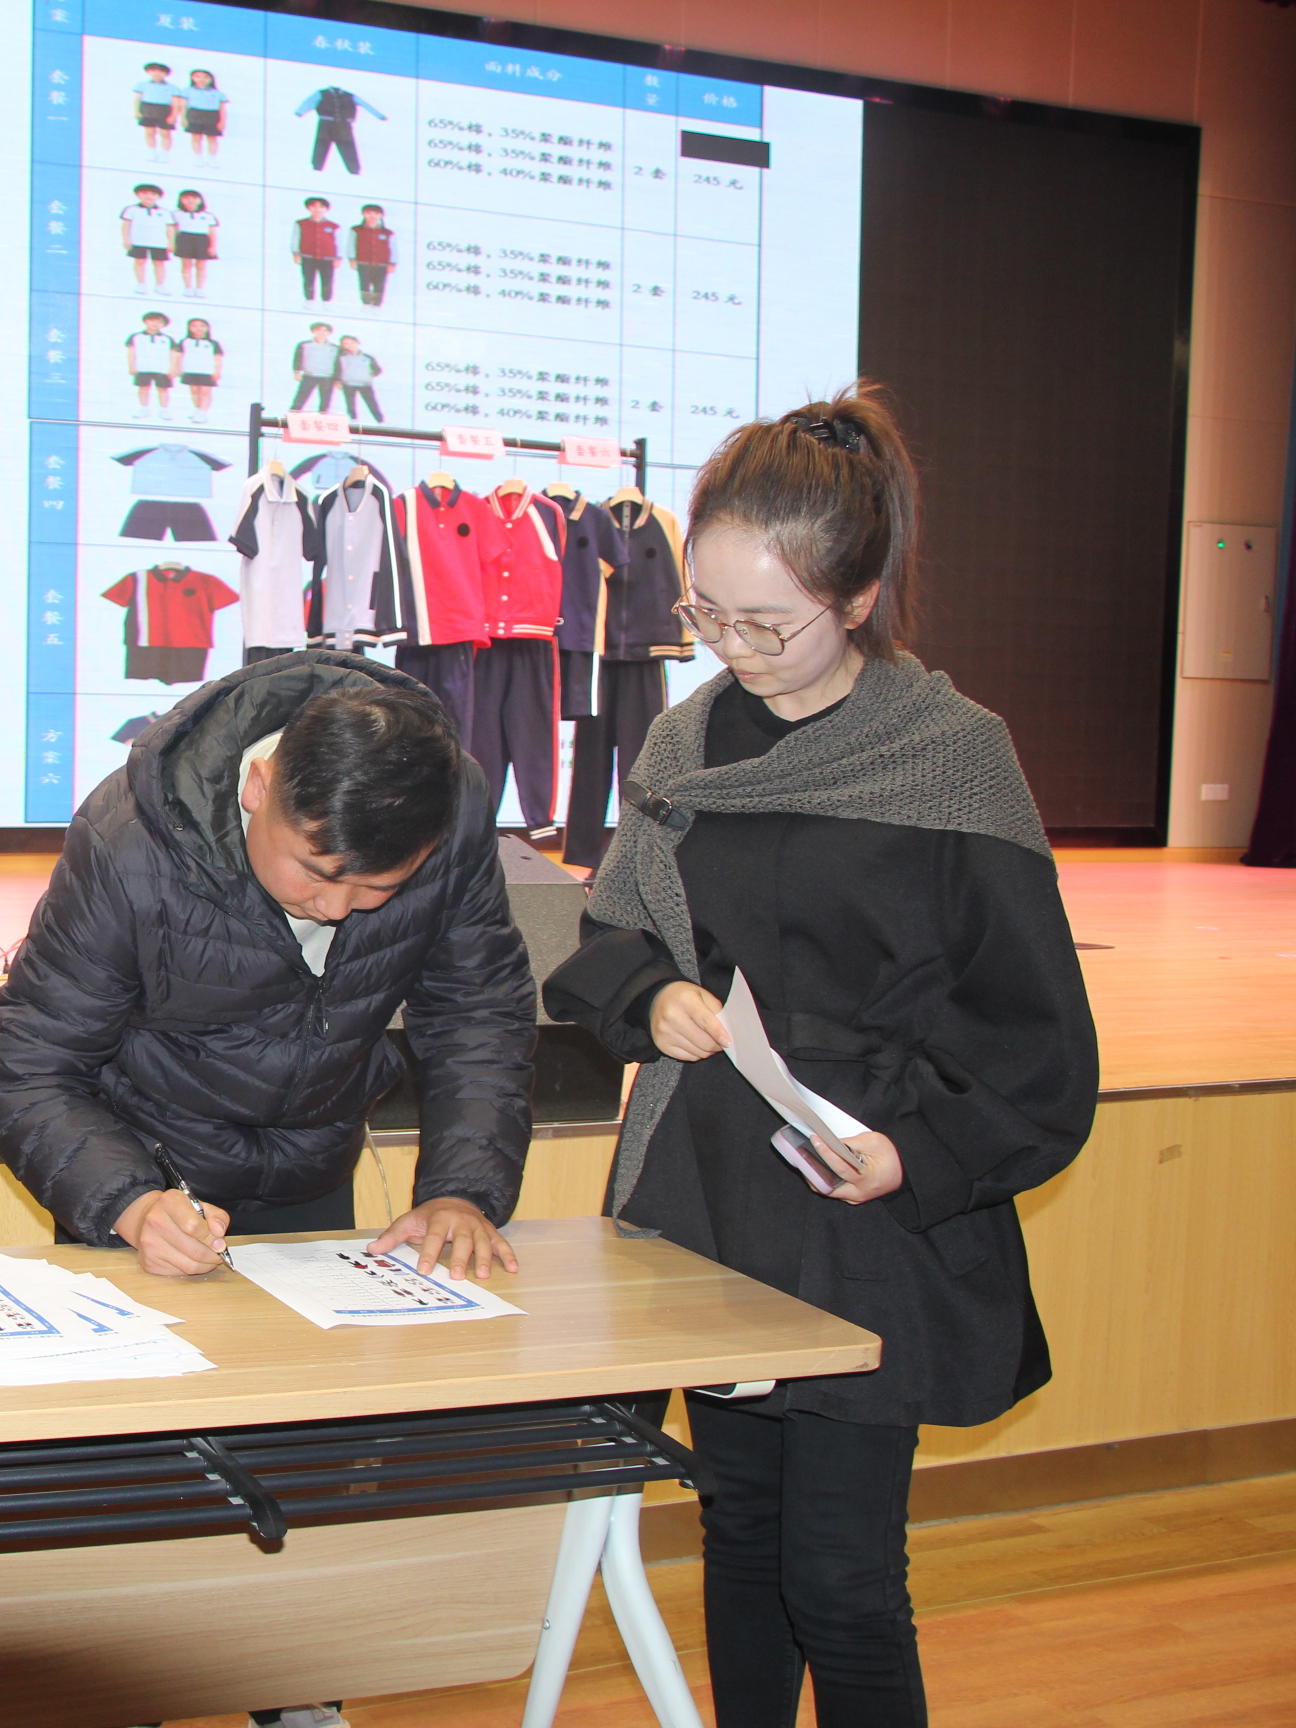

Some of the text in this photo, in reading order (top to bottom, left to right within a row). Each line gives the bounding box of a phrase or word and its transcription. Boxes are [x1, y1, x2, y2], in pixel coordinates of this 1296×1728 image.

[154, 13, 199, 31] 夏装
[311, 34, 376, 55] 春秋装
[484, 60, 563, 83] 面料成分
[702, 92, 738, 108] 价格
[299, 418, 339, 433] 套餐四
[456, 433, 495, 447] 套餐五
[575, 444, 611, 458] 套餐六
